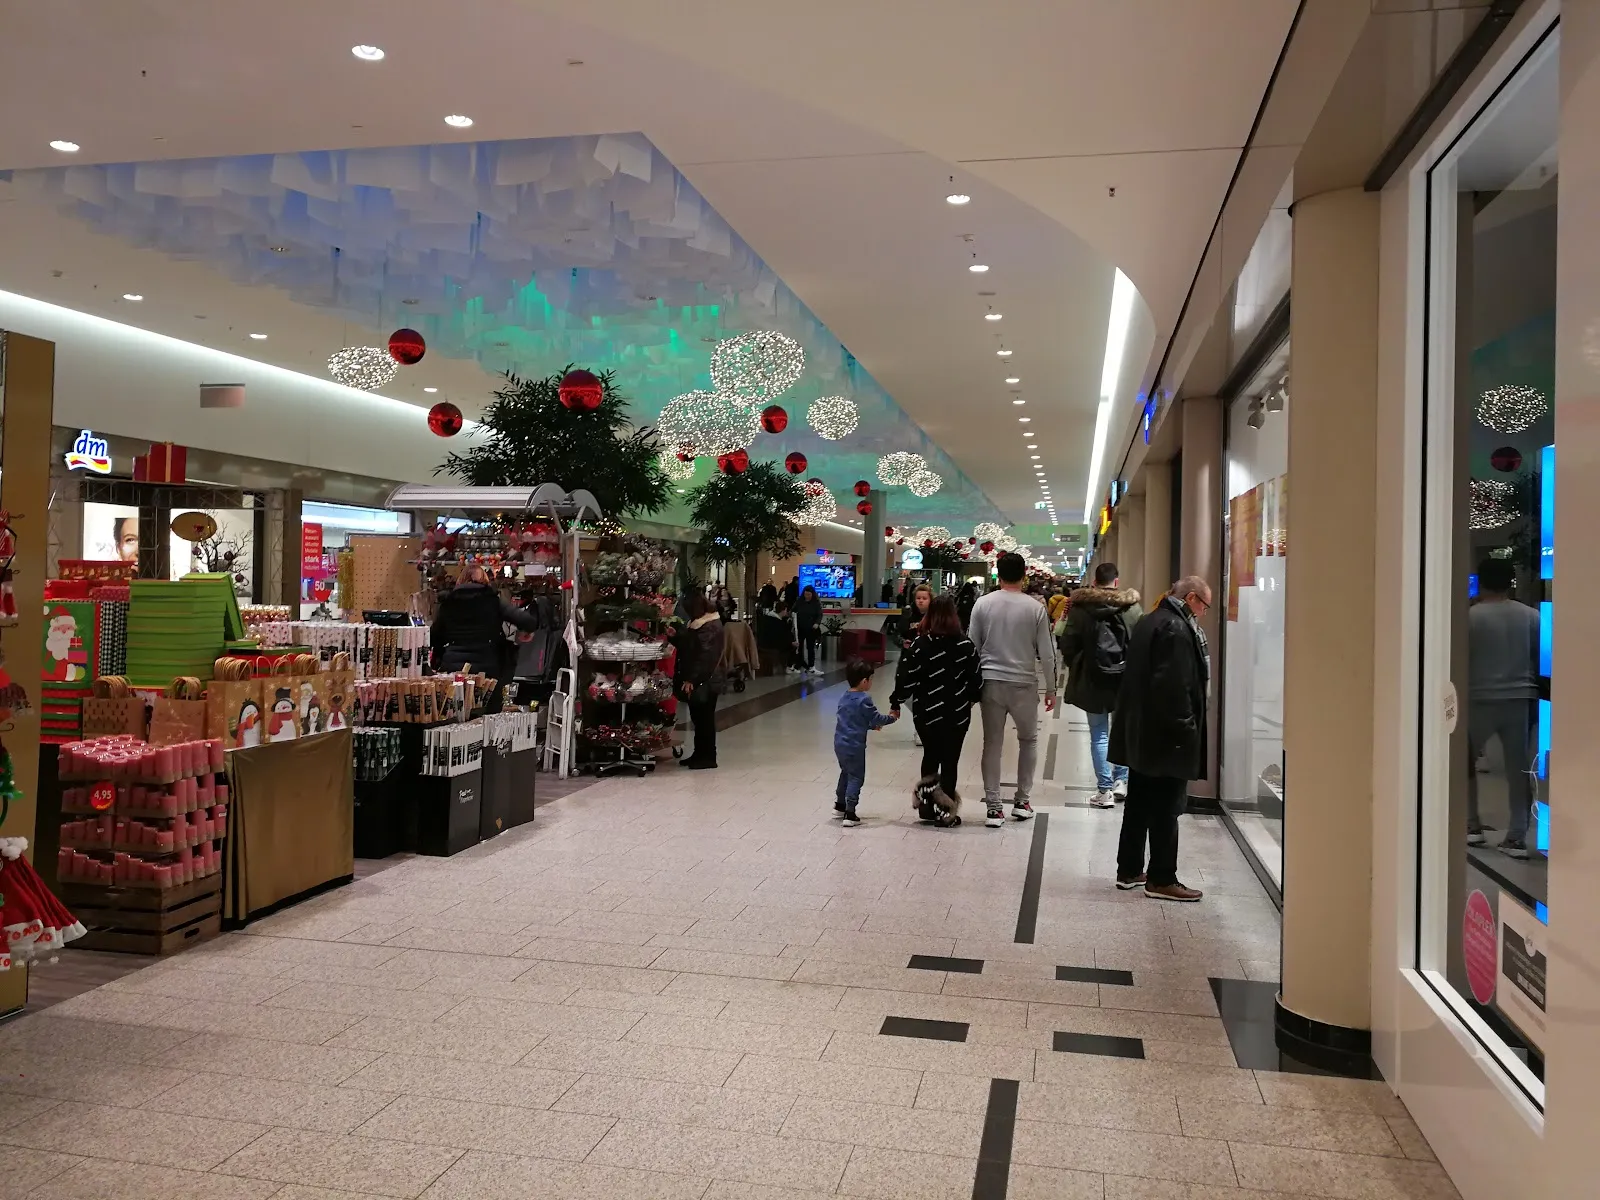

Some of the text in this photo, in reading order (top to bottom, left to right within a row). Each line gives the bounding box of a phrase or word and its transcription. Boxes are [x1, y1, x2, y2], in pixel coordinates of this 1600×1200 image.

[76, 432, 105, 457] dm
[819, 555, 835, 564] sky
[315, 581, 325, 591] 50
[94, 789, 112, 801] 4,95
